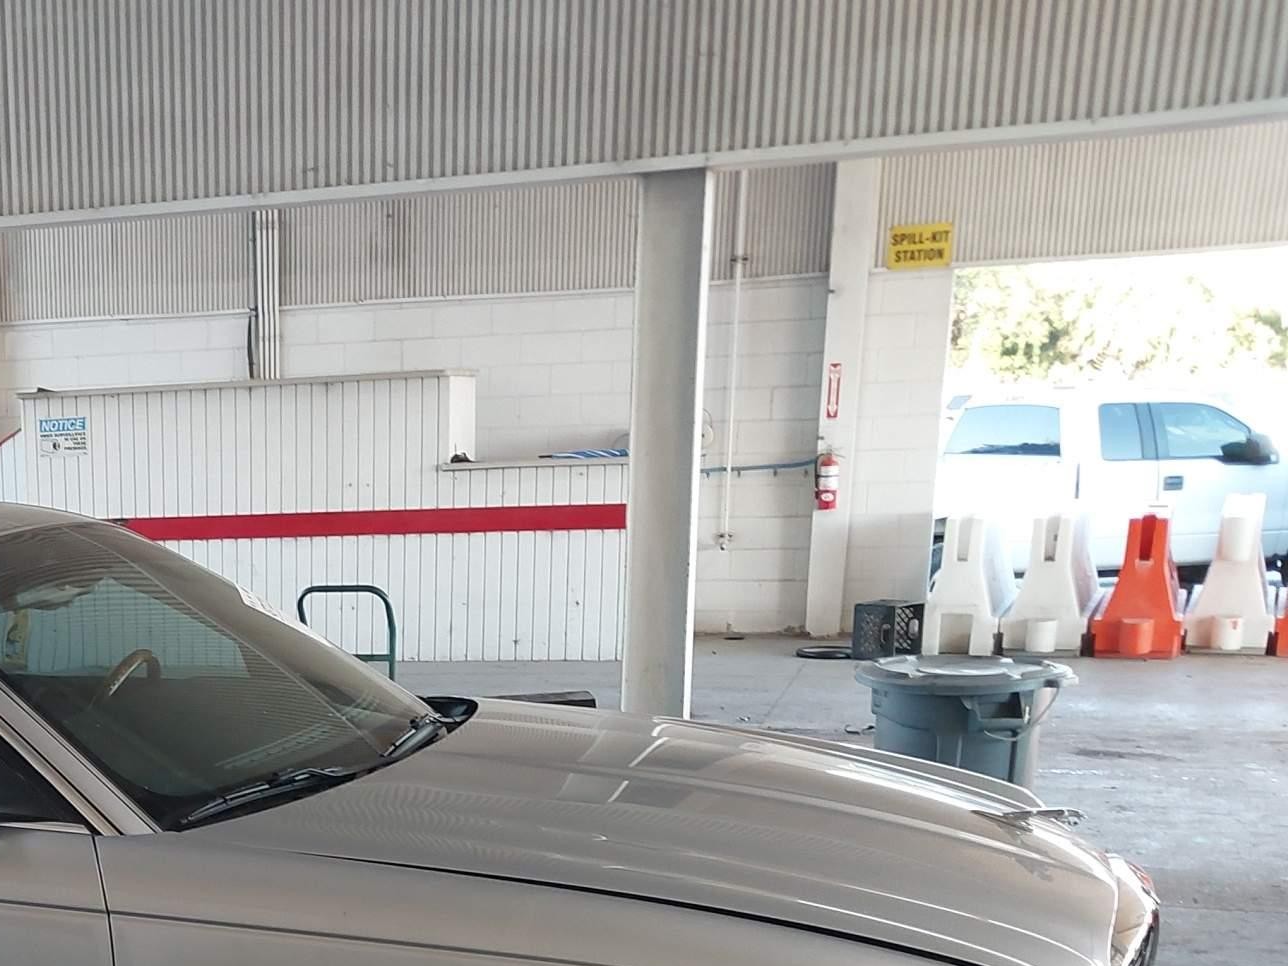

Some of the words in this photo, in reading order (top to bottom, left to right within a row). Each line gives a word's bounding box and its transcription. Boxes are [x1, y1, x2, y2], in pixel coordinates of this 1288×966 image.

[892, 230, 951, 246] SPILL-KIT
[895, 248, 944, 263] STATION
[41, 419, 84, 431] NOTICE
